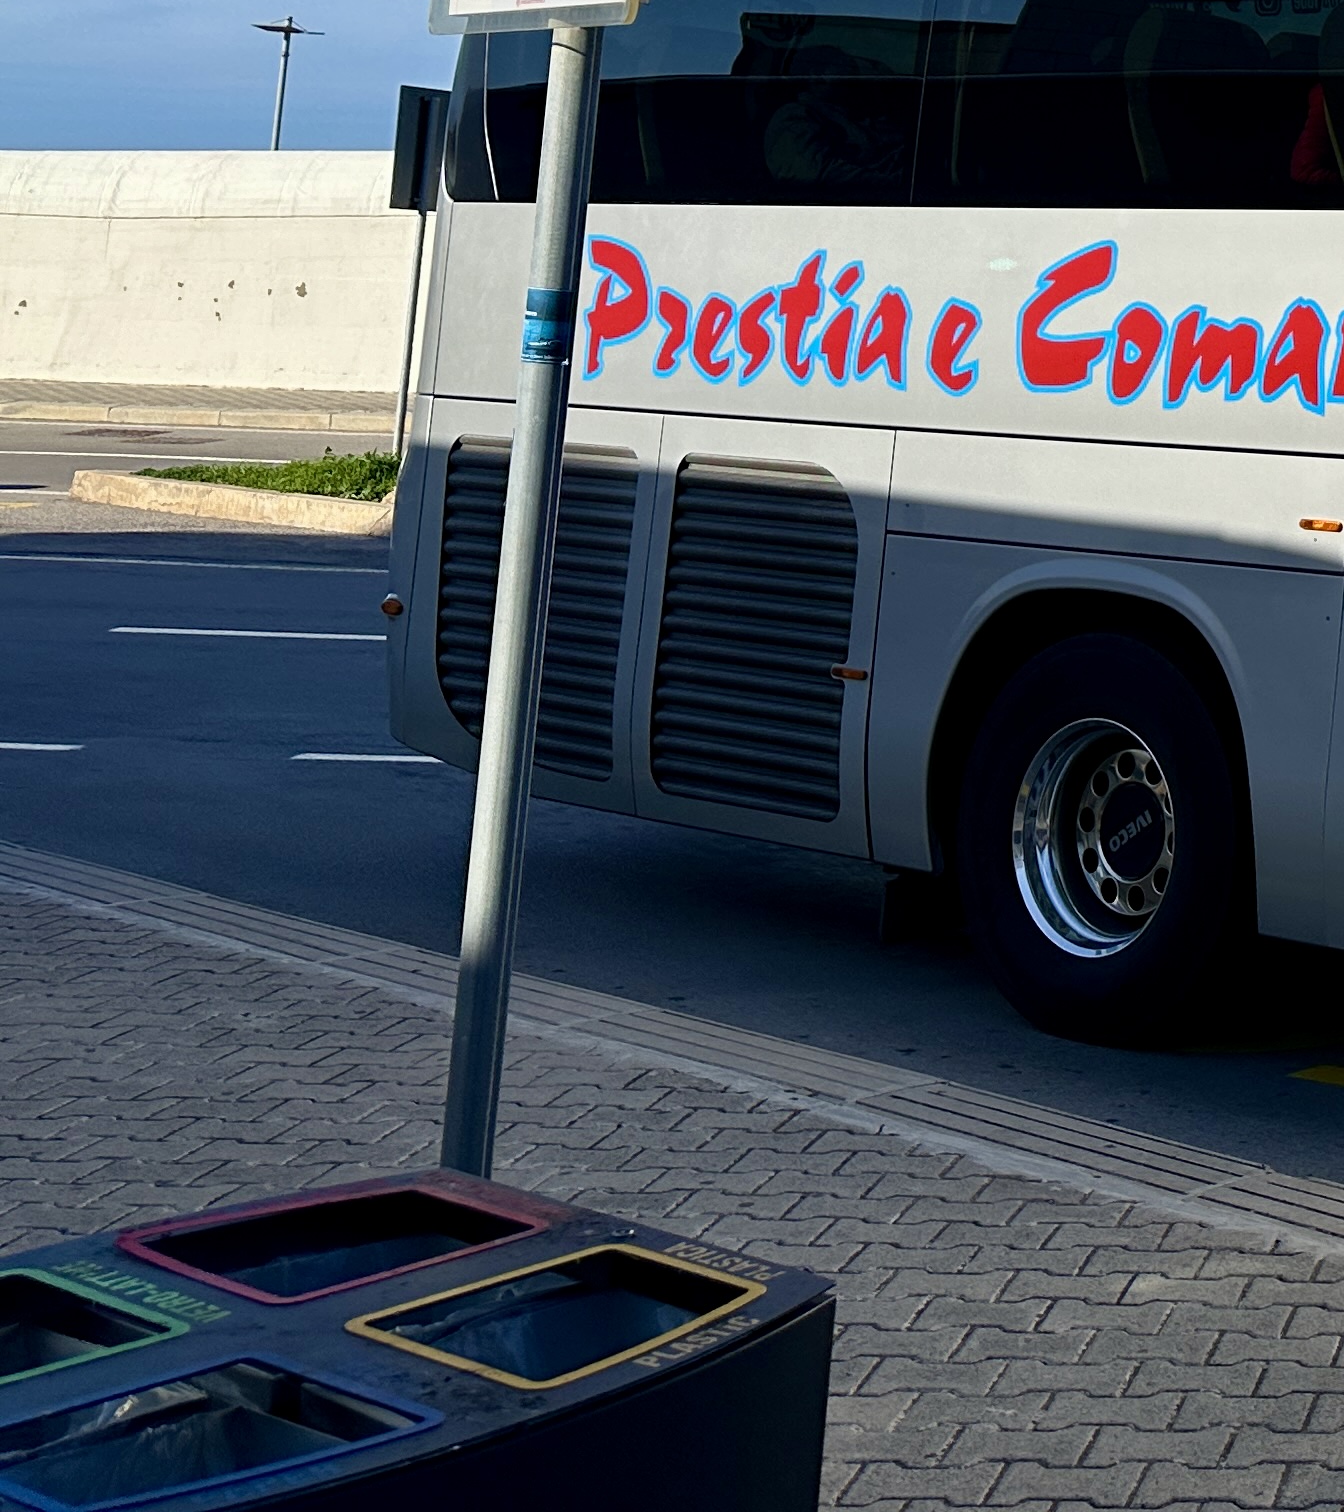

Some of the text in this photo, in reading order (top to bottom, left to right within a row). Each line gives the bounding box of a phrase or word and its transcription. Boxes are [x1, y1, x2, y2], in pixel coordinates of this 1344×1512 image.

[583, 234, 908, 391] Prestia
[926, 296, 984, 397] e
[1108, 809, 1153, 852] IVECO
[663, 1241, 787, 1282] PLASTICA
[632, 1315, 761, 1368] PLASTIC
